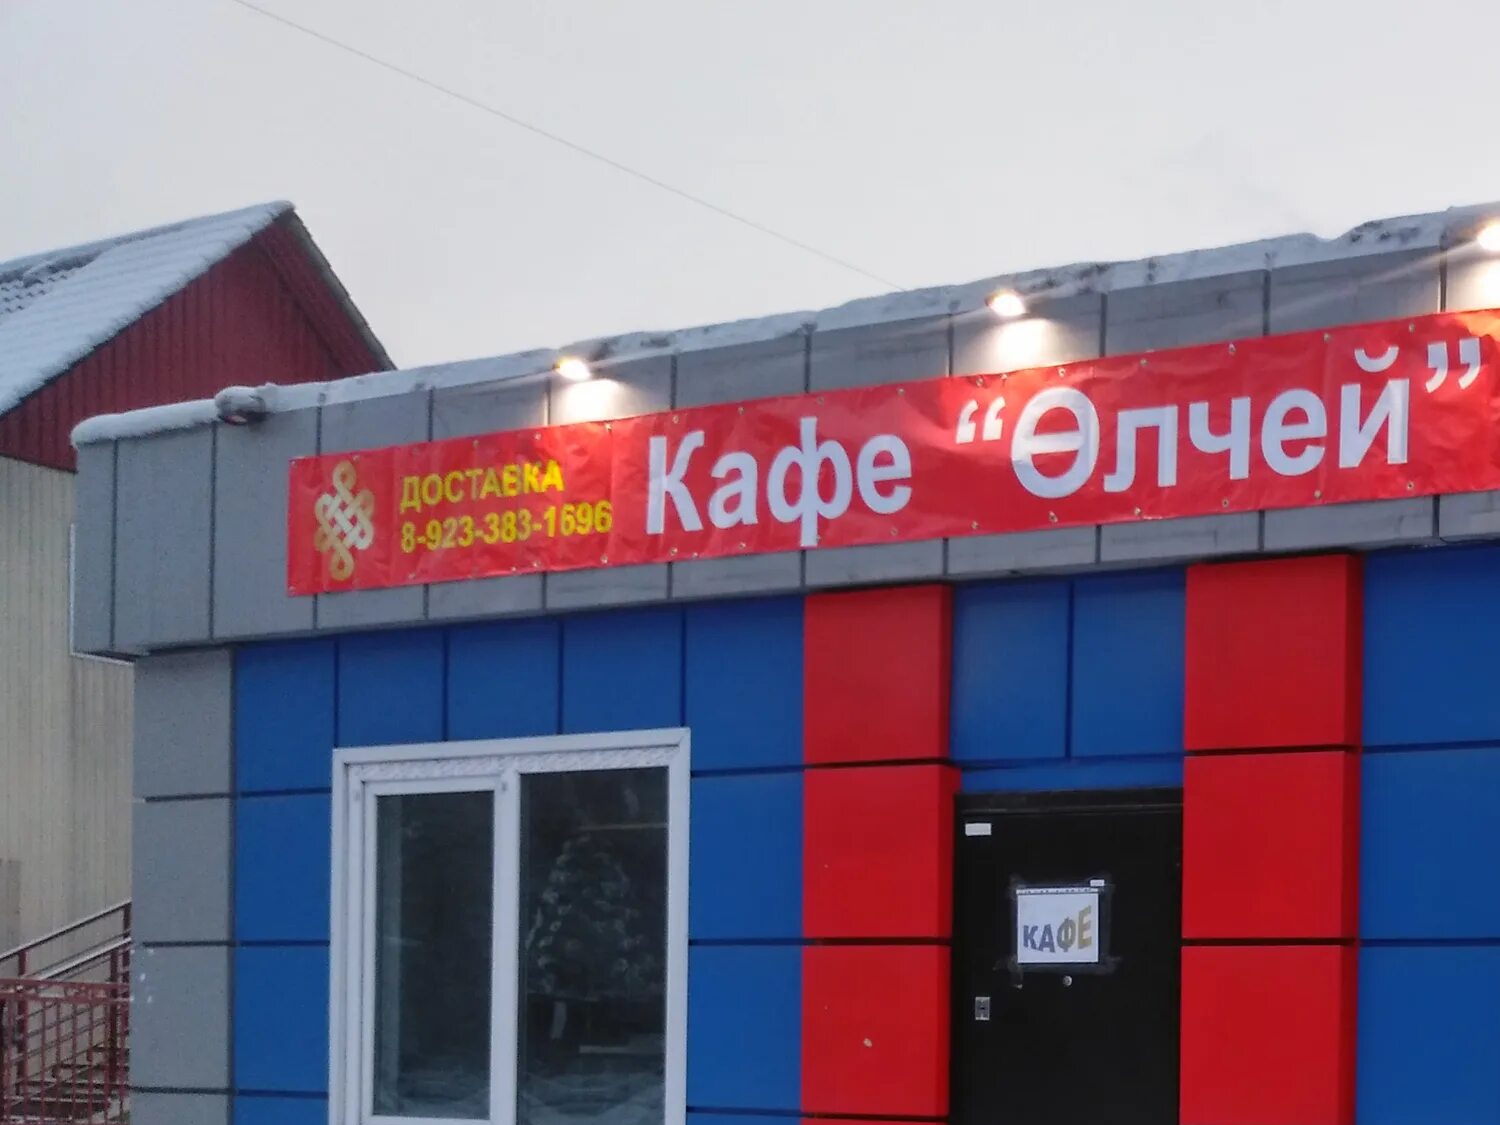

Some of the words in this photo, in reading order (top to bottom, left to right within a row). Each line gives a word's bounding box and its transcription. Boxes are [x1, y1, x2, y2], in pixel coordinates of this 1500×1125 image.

[400, 459, 565, 513] ДОСТАВКА
[647, 416, 912, 547] Кафе
[401, 501, 613, 553] 8-923-383-1696
[1023, 905, 1092, 953] КАФЕ
